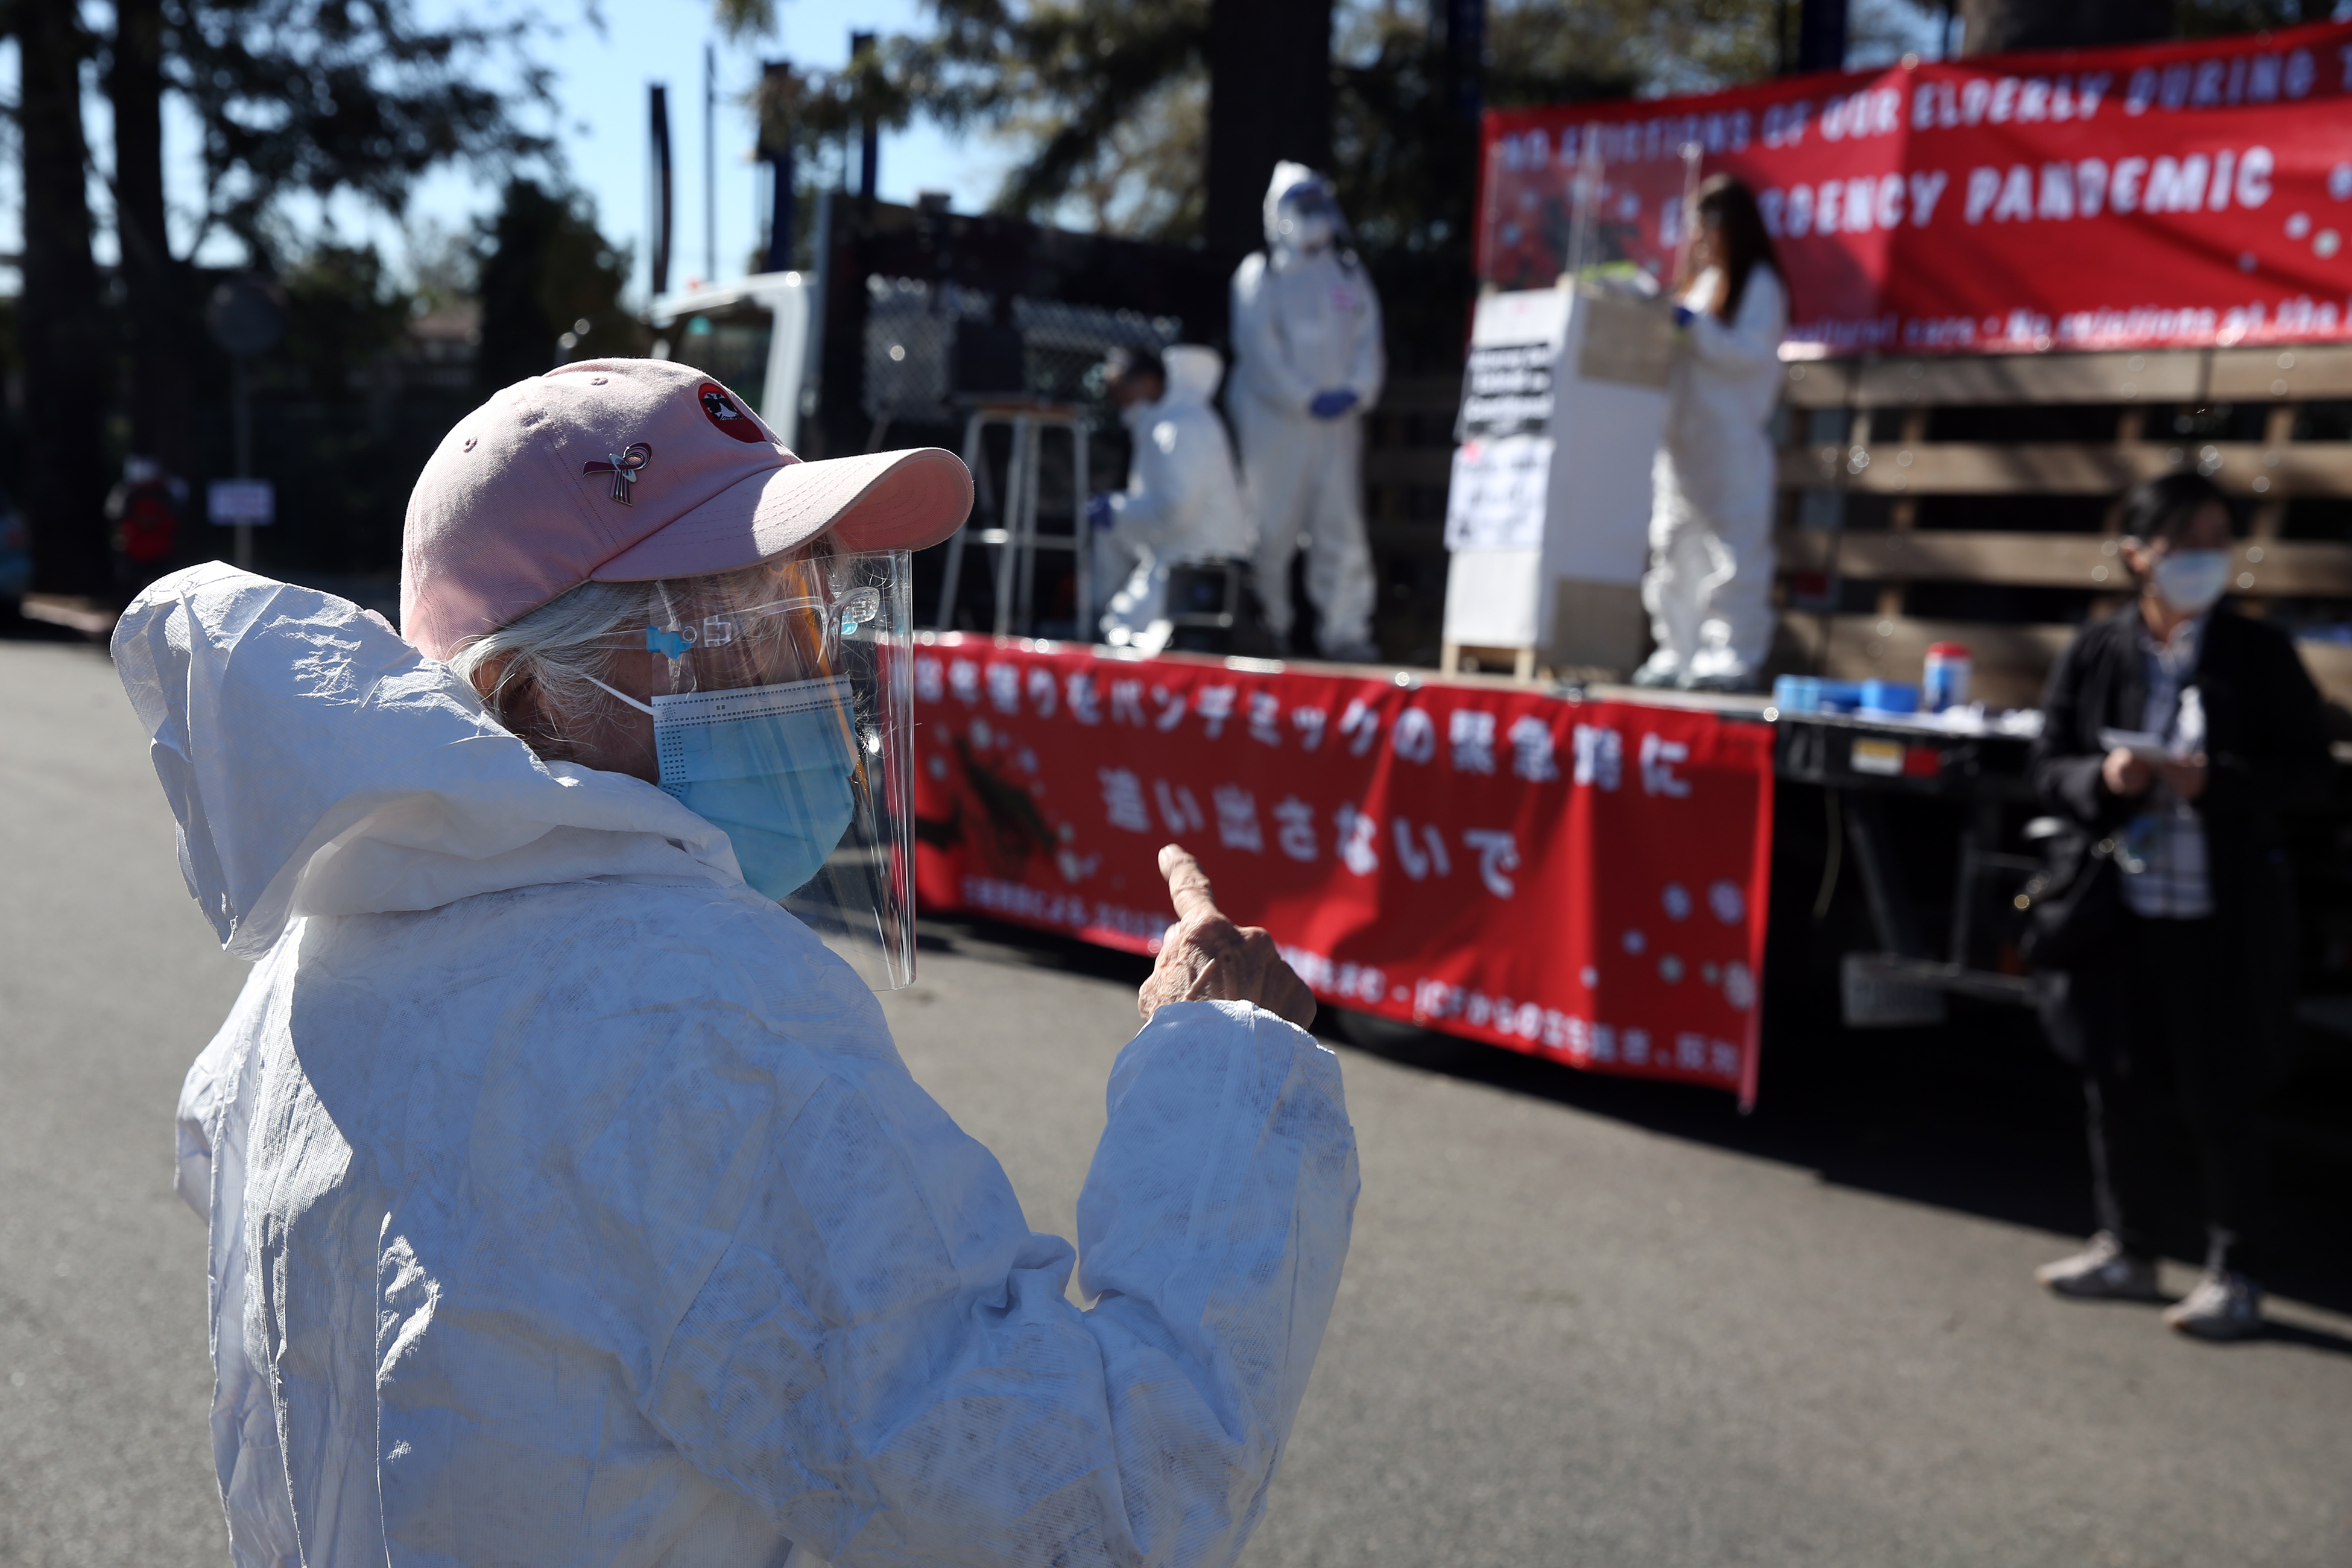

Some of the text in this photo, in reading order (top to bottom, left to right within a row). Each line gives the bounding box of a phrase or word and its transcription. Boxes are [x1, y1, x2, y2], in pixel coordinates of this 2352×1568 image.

[1760, 100, 1811, 148] OF
[1820, 86, 1901, 142] OUR
[1909, 69, 2112, 130] ELDERLY
[2124, 48, 2316, 115] DURING
[1964, 145, 2275, 224] PANDEMIC
[2005, 307, 2052, 345] No
[2275, 294, 2339, 334] the
